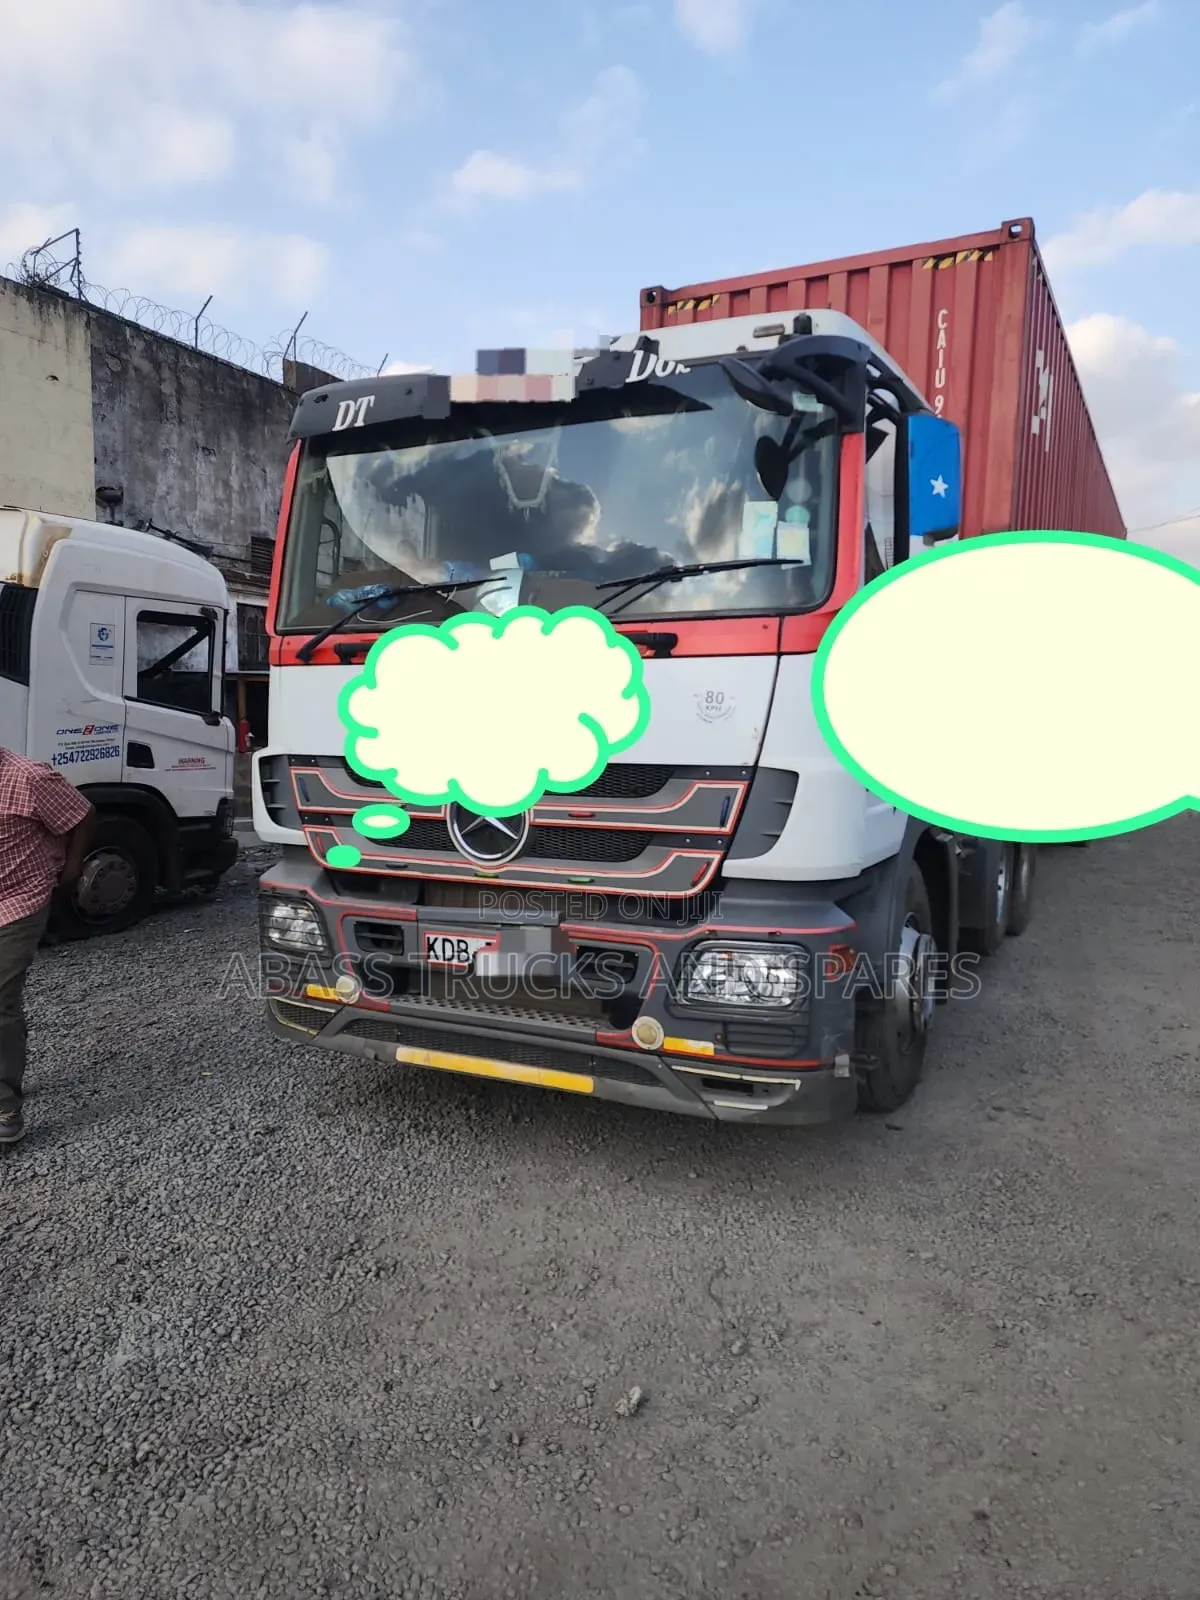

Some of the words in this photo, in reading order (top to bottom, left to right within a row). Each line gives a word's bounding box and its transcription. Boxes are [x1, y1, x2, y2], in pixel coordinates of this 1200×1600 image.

[935, 309, 948, 388] CAIU
[331, 394, 376, 432] DT
[704, 690, 725, 705] 80
[426, 936, 470, 963] KDB
